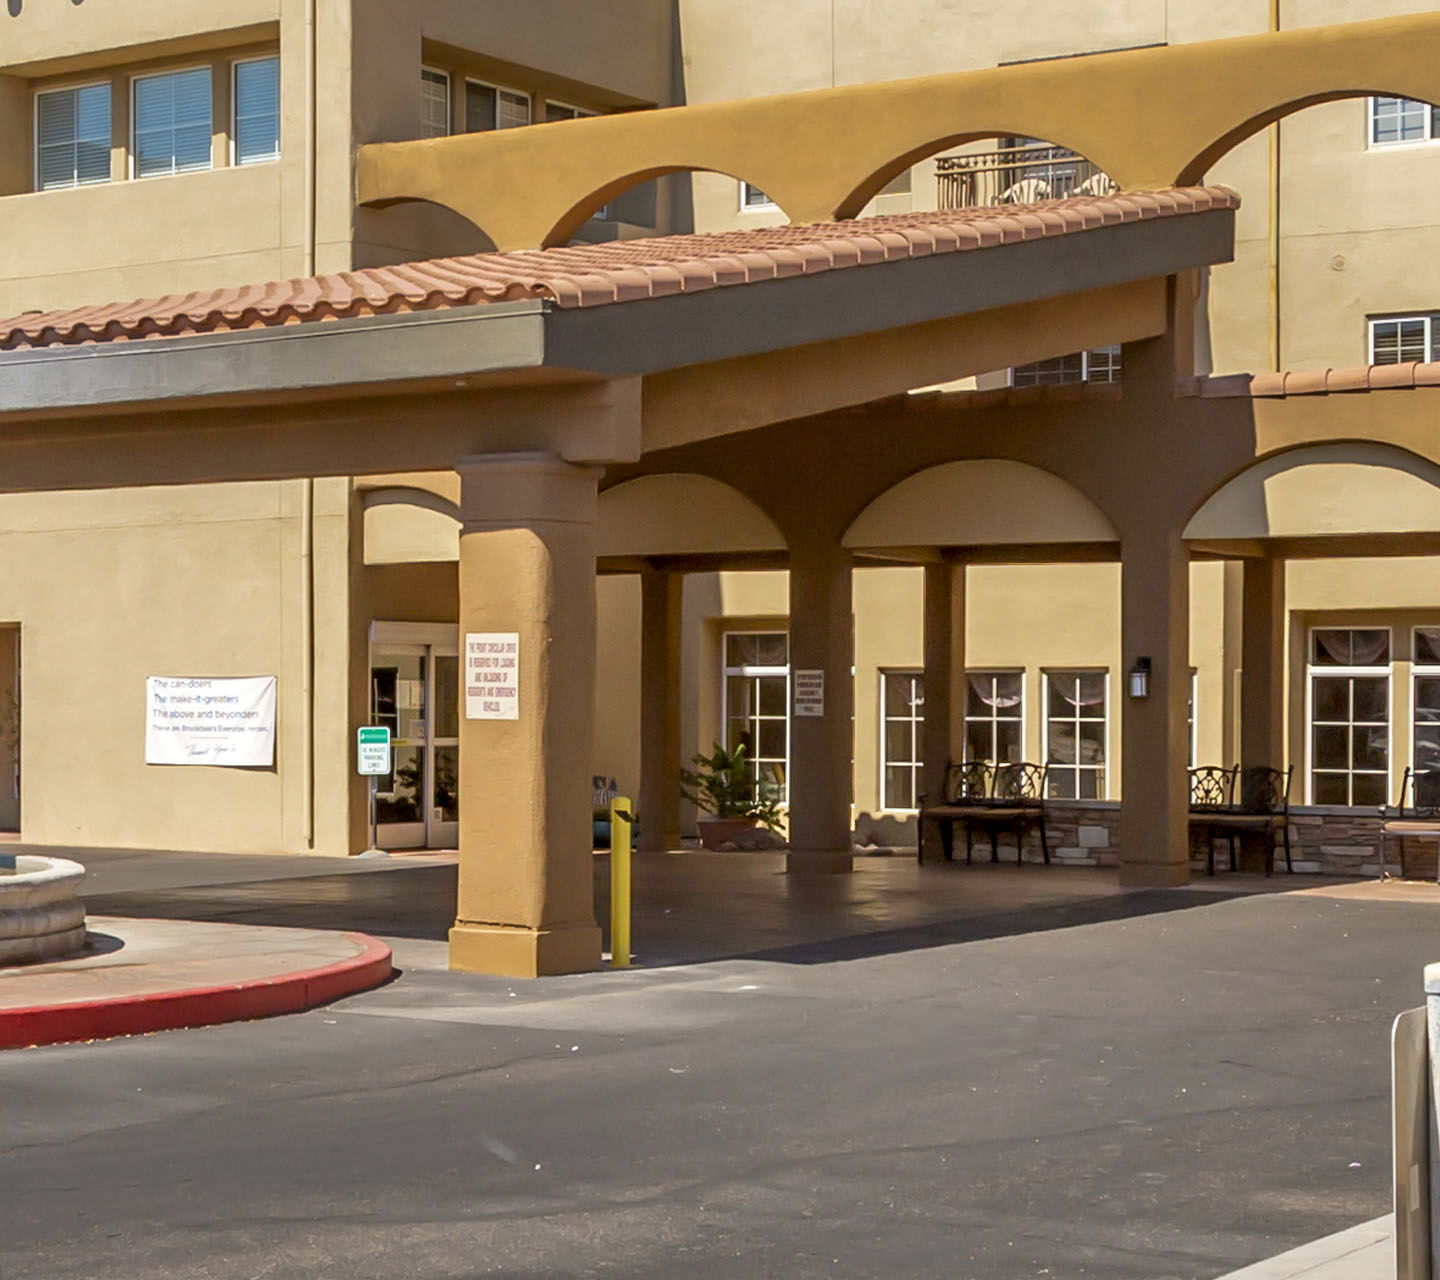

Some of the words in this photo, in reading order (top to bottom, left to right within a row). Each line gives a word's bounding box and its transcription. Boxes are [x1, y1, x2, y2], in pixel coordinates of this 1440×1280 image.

[153, 679, 167, 688] The
[170, 679, 212, 688] can-doers
[154, 693, 167, 703] The
[153, 709, 168, 718] The
[169, 709, 195, 718] above
[197, 709, 213, 718] and
